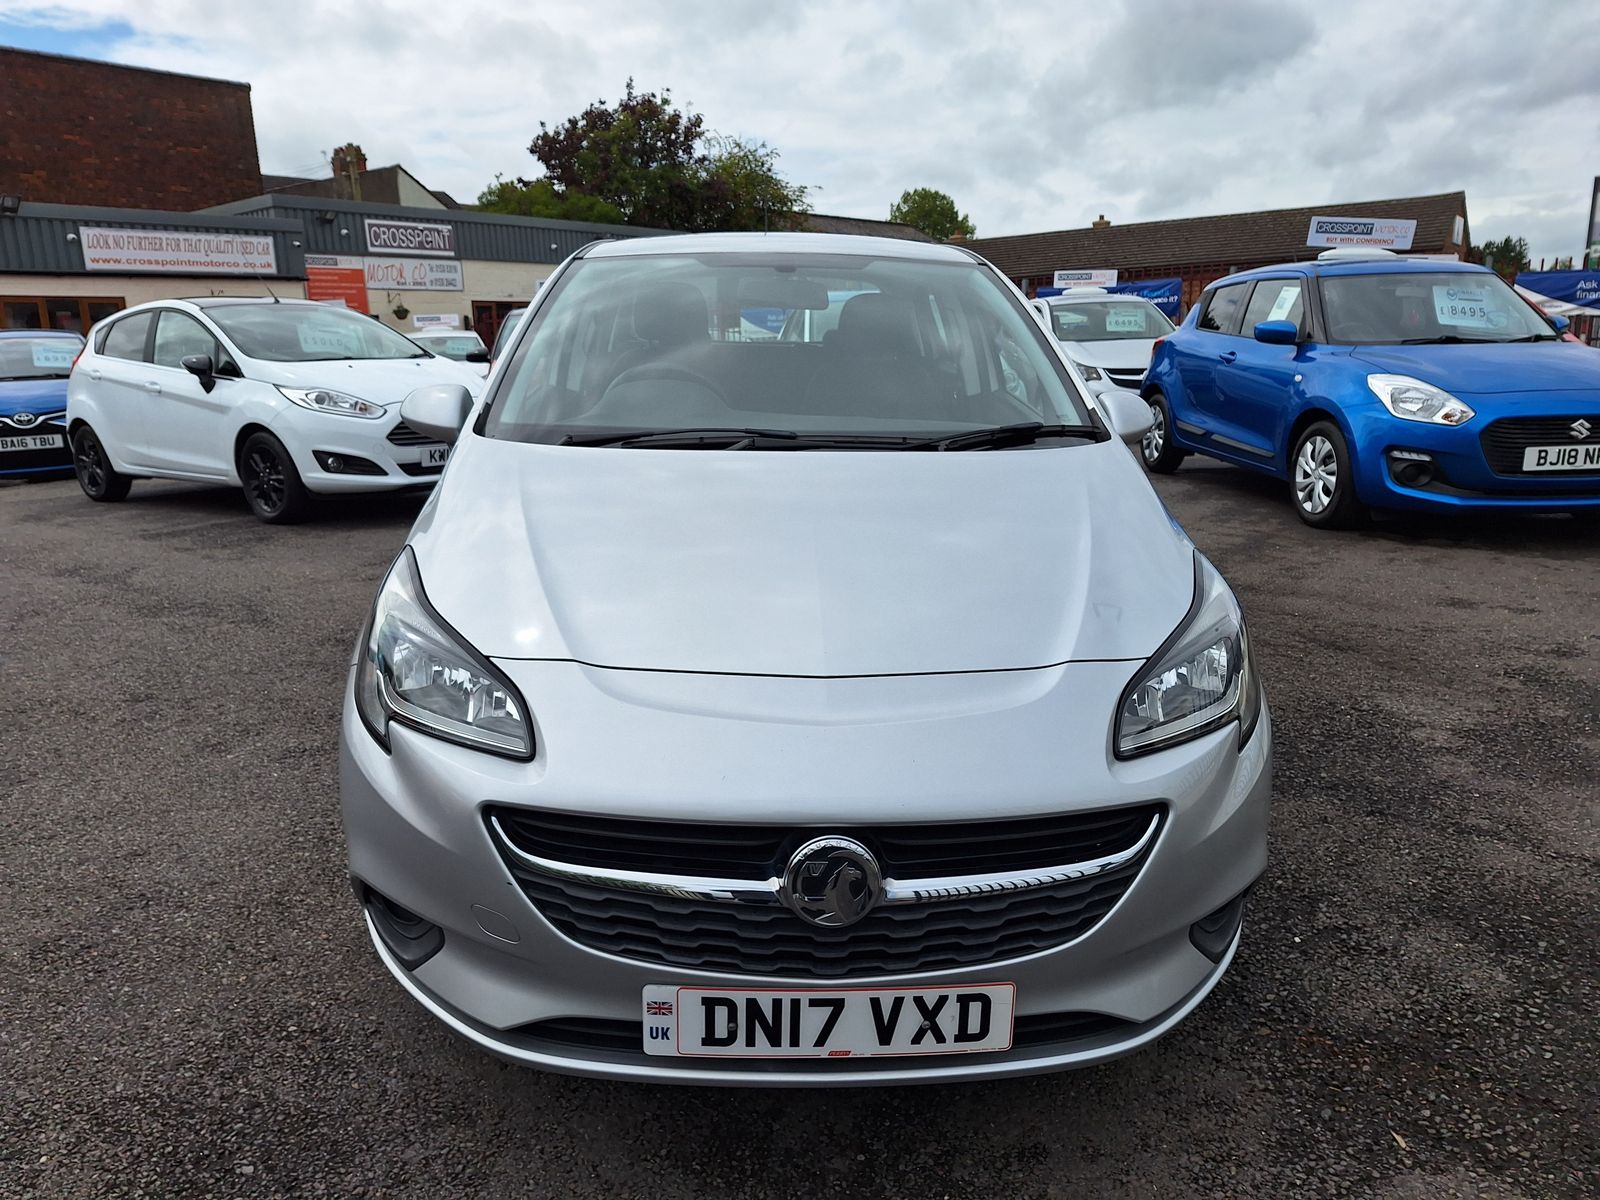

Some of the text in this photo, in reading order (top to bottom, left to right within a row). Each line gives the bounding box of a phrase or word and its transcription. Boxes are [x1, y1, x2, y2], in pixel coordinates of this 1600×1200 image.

[1317, 223, 1373, 234] CROSSPOINT
[87, 234, 270, 256] LOOK NO FURTHER FOR THAT QUALITY USED CAR
[370, 226, 450, 249] CROSSPOINT
[90, 256, 273, 269] www.crosspointmotorco.co.uk
[367, 263, 406, 283] MOTOR
[412, 262, 427, 280] CO
[1576, 280, 1598, 289] Ask
[1, 436, 55, 449] BA16 TBU
[1536, 448, 1579, 467] BJ18
[700, 993, 993, 1047] DN17 VXD
[649, 1026, 670, 1041] UK
